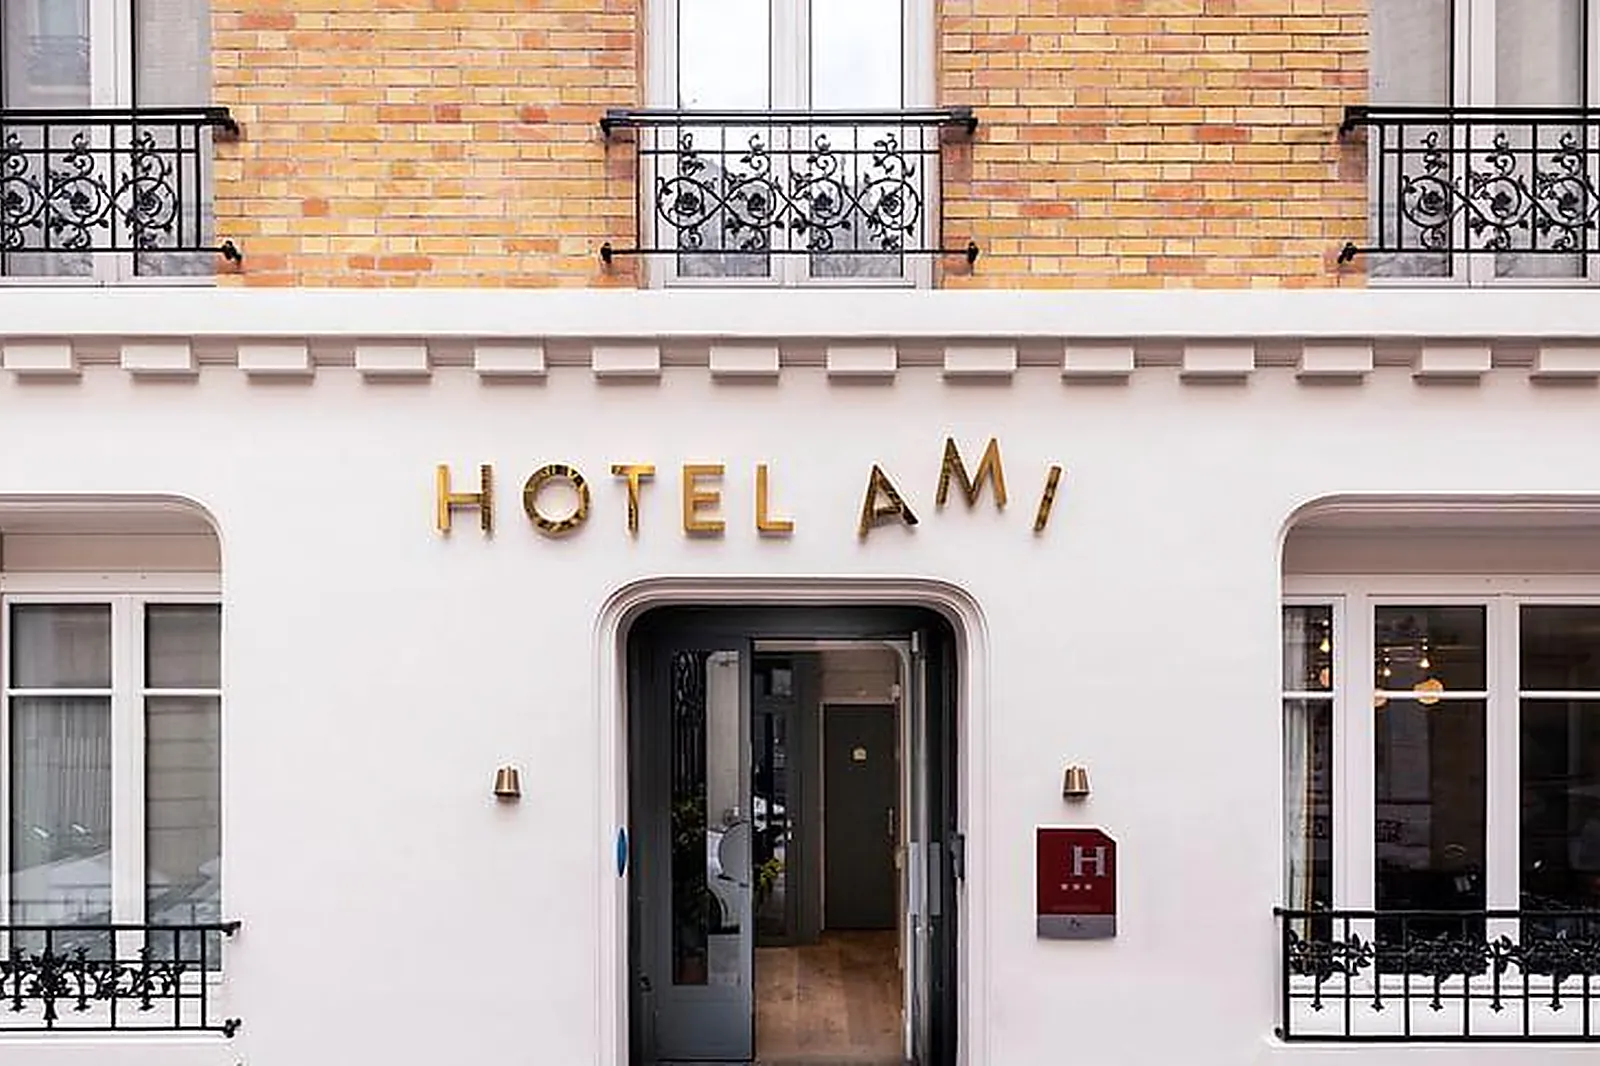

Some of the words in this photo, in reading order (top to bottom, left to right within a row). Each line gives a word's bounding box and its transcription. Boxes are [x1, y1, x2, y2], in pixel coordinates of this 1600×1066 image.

[437, 464, 794, 537] HOTEL
[859, 436, 1062, 540] AMI
[1073, 846, 1105, 876] H
